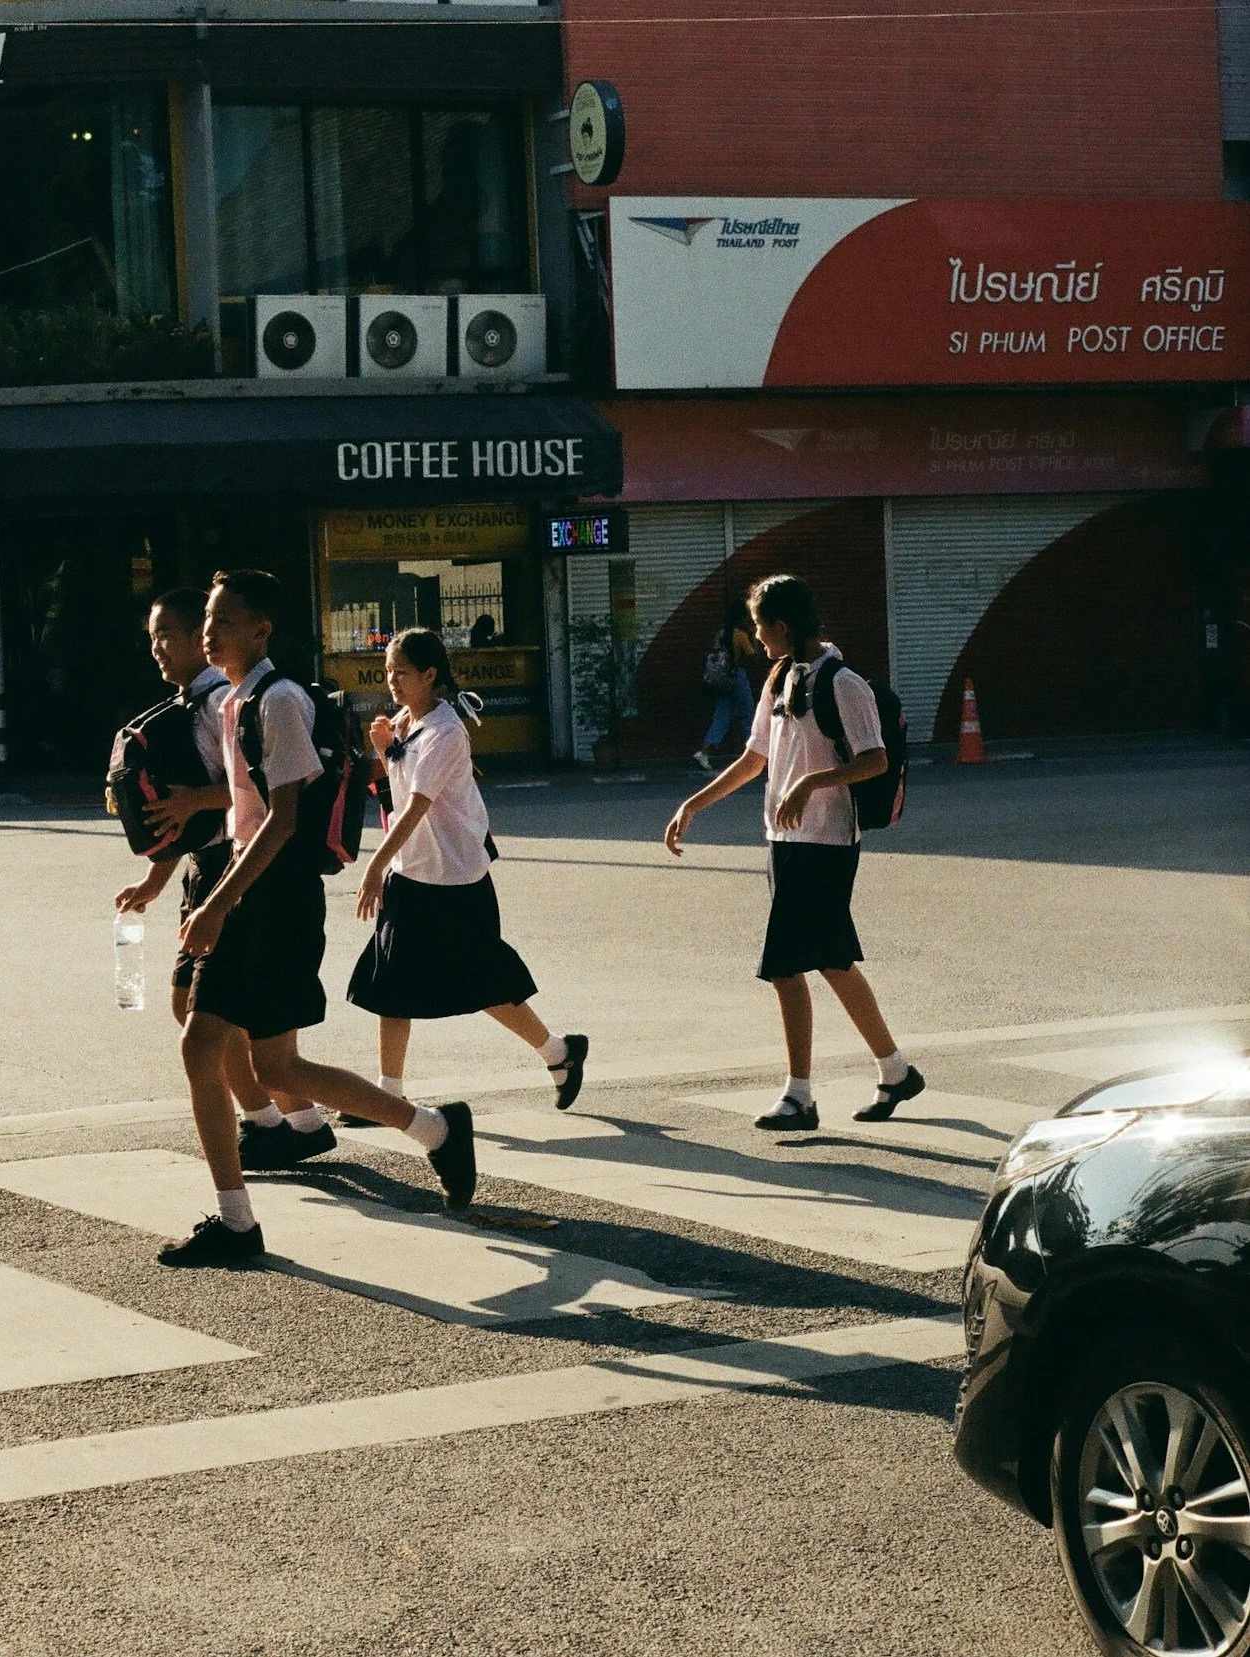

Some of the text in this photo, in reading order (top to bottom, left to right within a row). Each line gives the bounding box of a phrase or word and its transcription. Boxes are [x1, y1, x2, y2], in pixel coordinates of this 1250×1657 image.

[716, 238, 800, 248] THAILAND POST
[949, 257, 1225, 312] ไปรษณีย์ ศรีภูมิ
[949, 325, 1226, 353] SI PHUM POST OFFICE
[337, 438, 584, 481] COFFEE HOUSE
[367, 511, 526, 529] MONEY EXCHANGE
[551, 519, 609, 548] EXCHANGE
